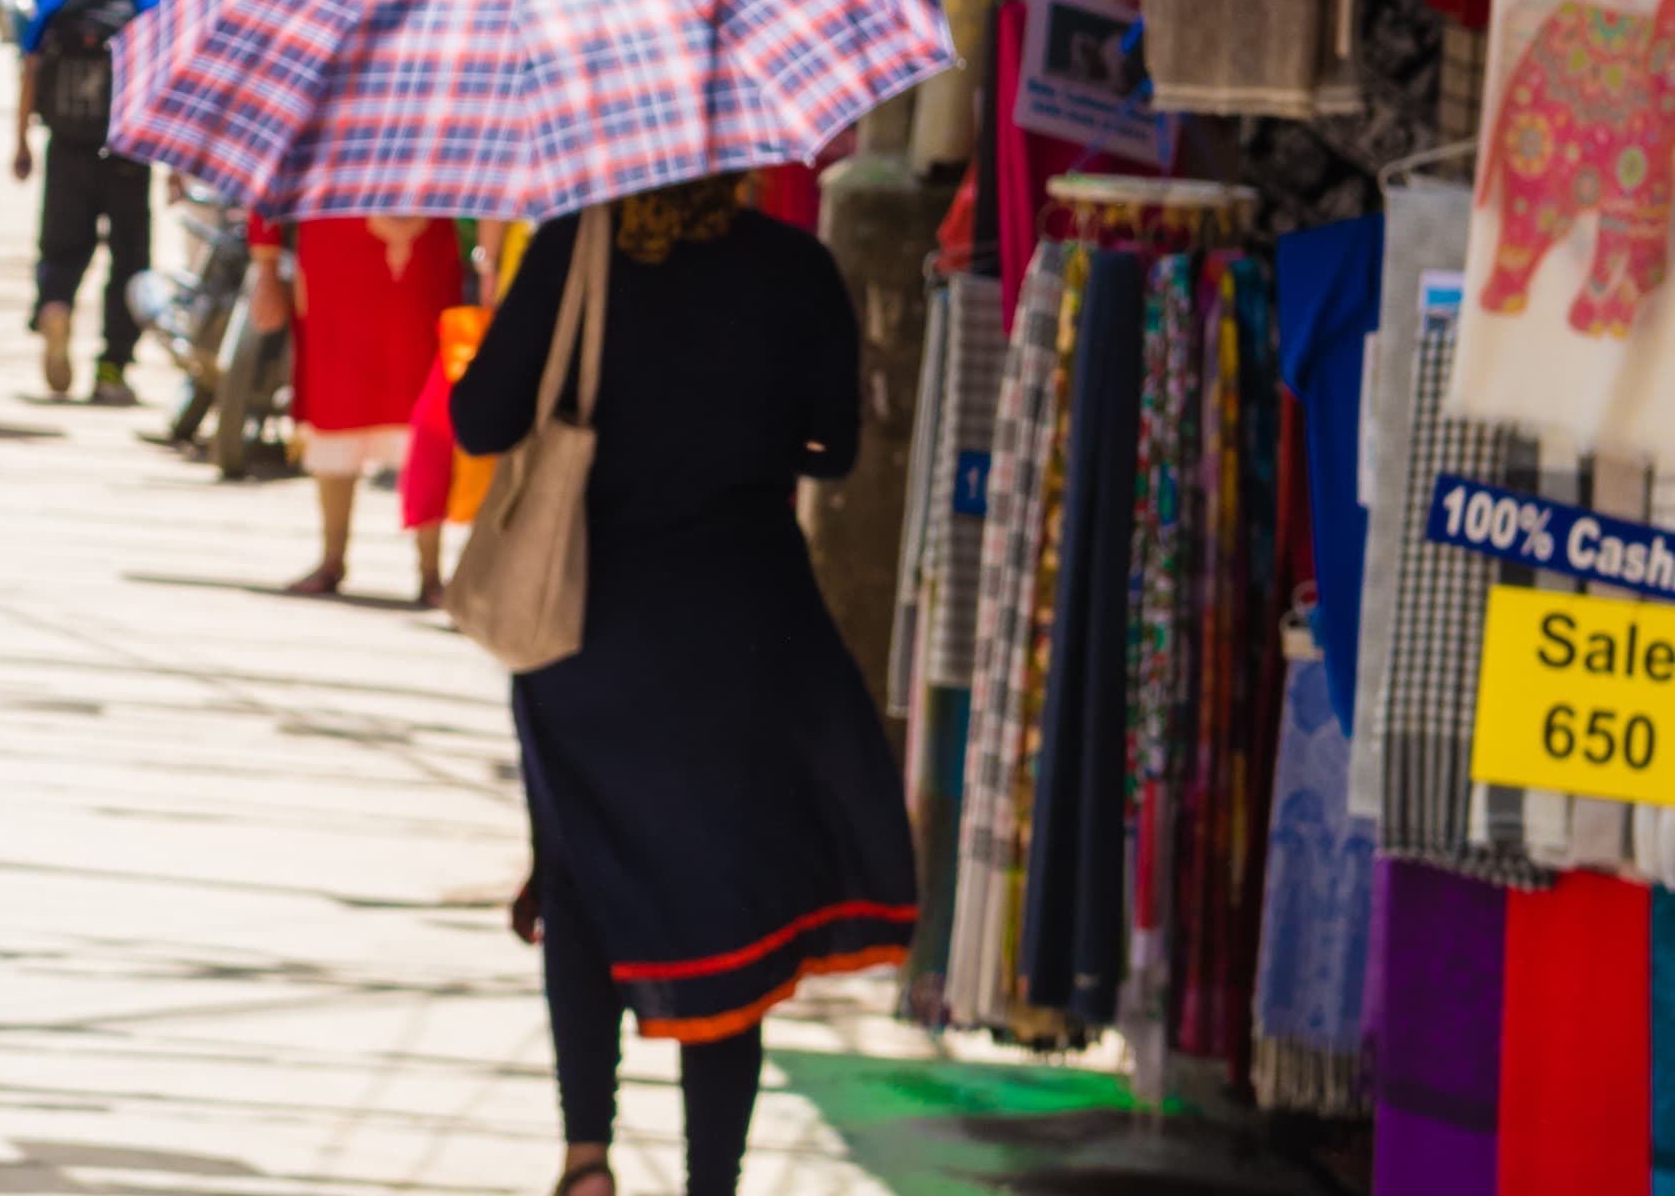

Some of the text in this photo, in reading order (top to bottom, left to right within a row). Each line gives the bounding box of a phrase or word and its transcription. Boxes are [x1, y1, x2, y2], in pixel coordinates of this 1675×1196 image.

[1443, 485, 1675, 591] 100% Cash
[1538, 612, 1675, 681] Sale
[1542, 702, 1656, 770] 650
